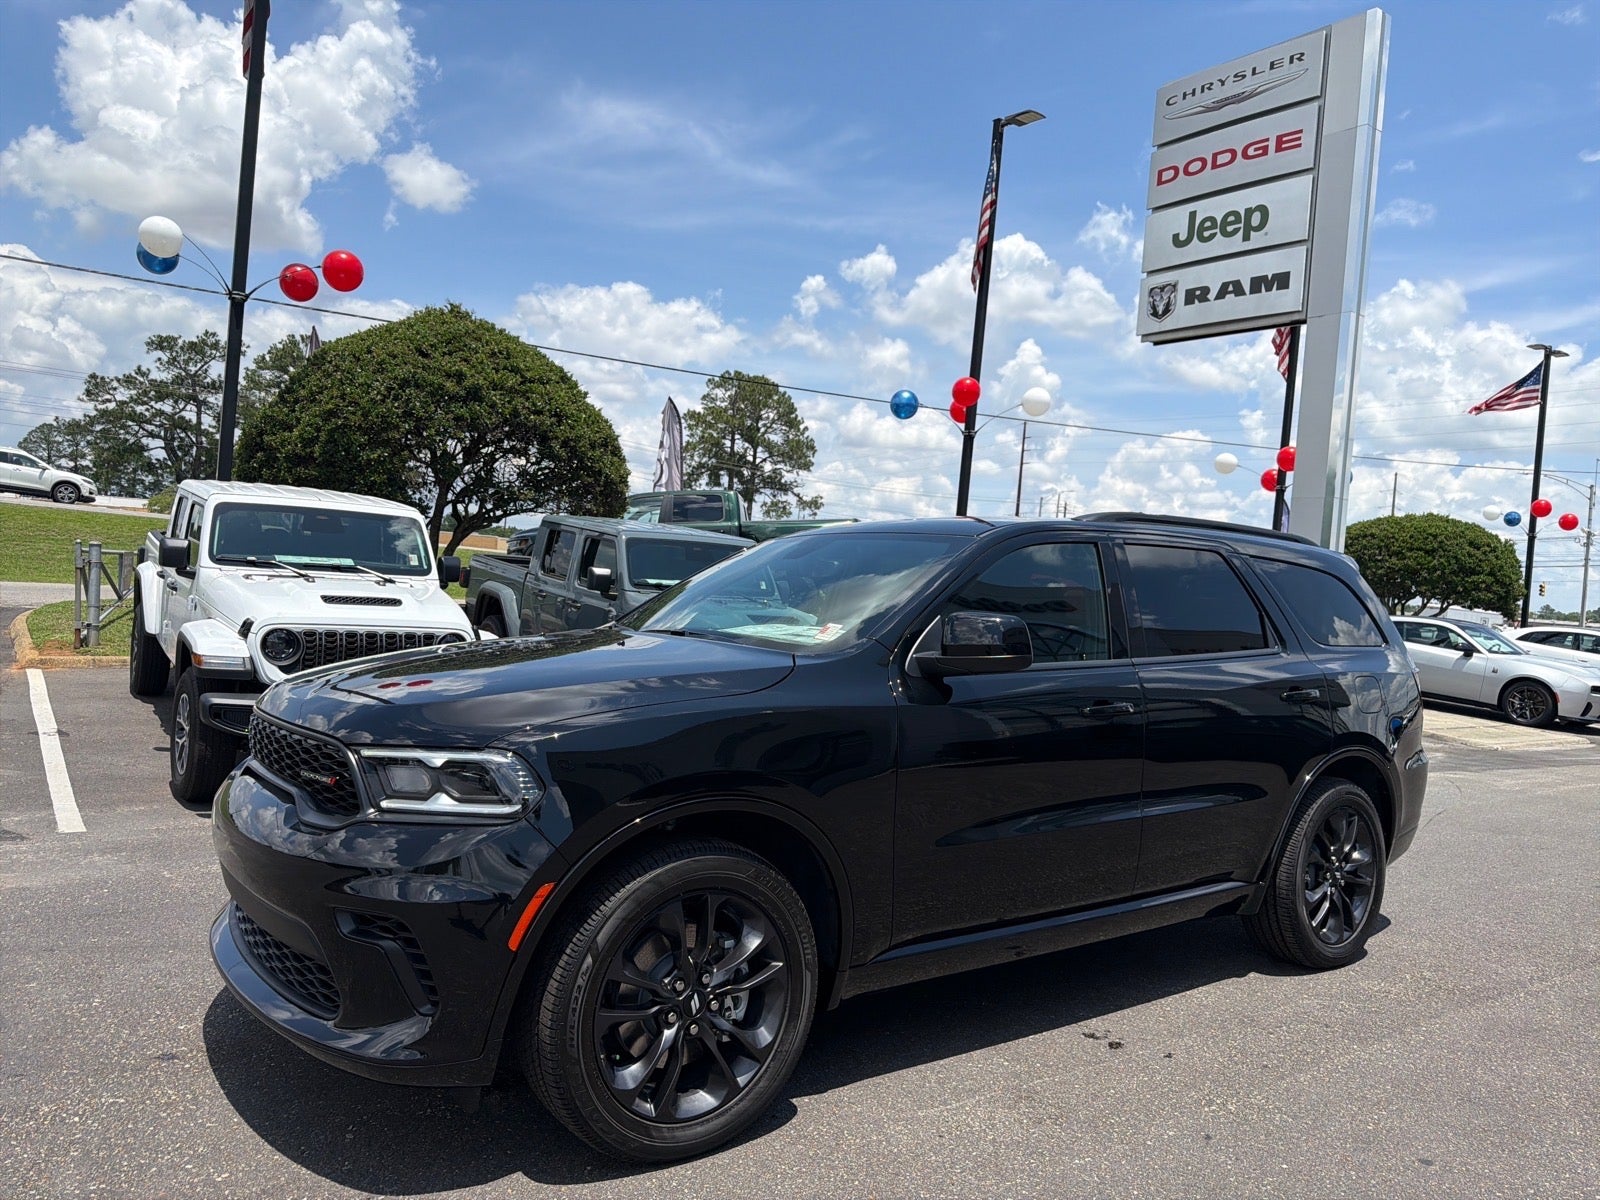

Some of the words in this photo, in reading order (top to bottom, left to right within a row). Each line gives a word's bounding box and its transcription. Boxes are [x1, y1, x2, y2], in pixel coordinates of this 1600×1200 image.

[1166, 52, 1306, 106] CHRYSLER
[1156, 129, 1303, 186] DODGE
[1172, 204, 1269, 248] Jeep
[1184, 271, 1291, 306] RAM
